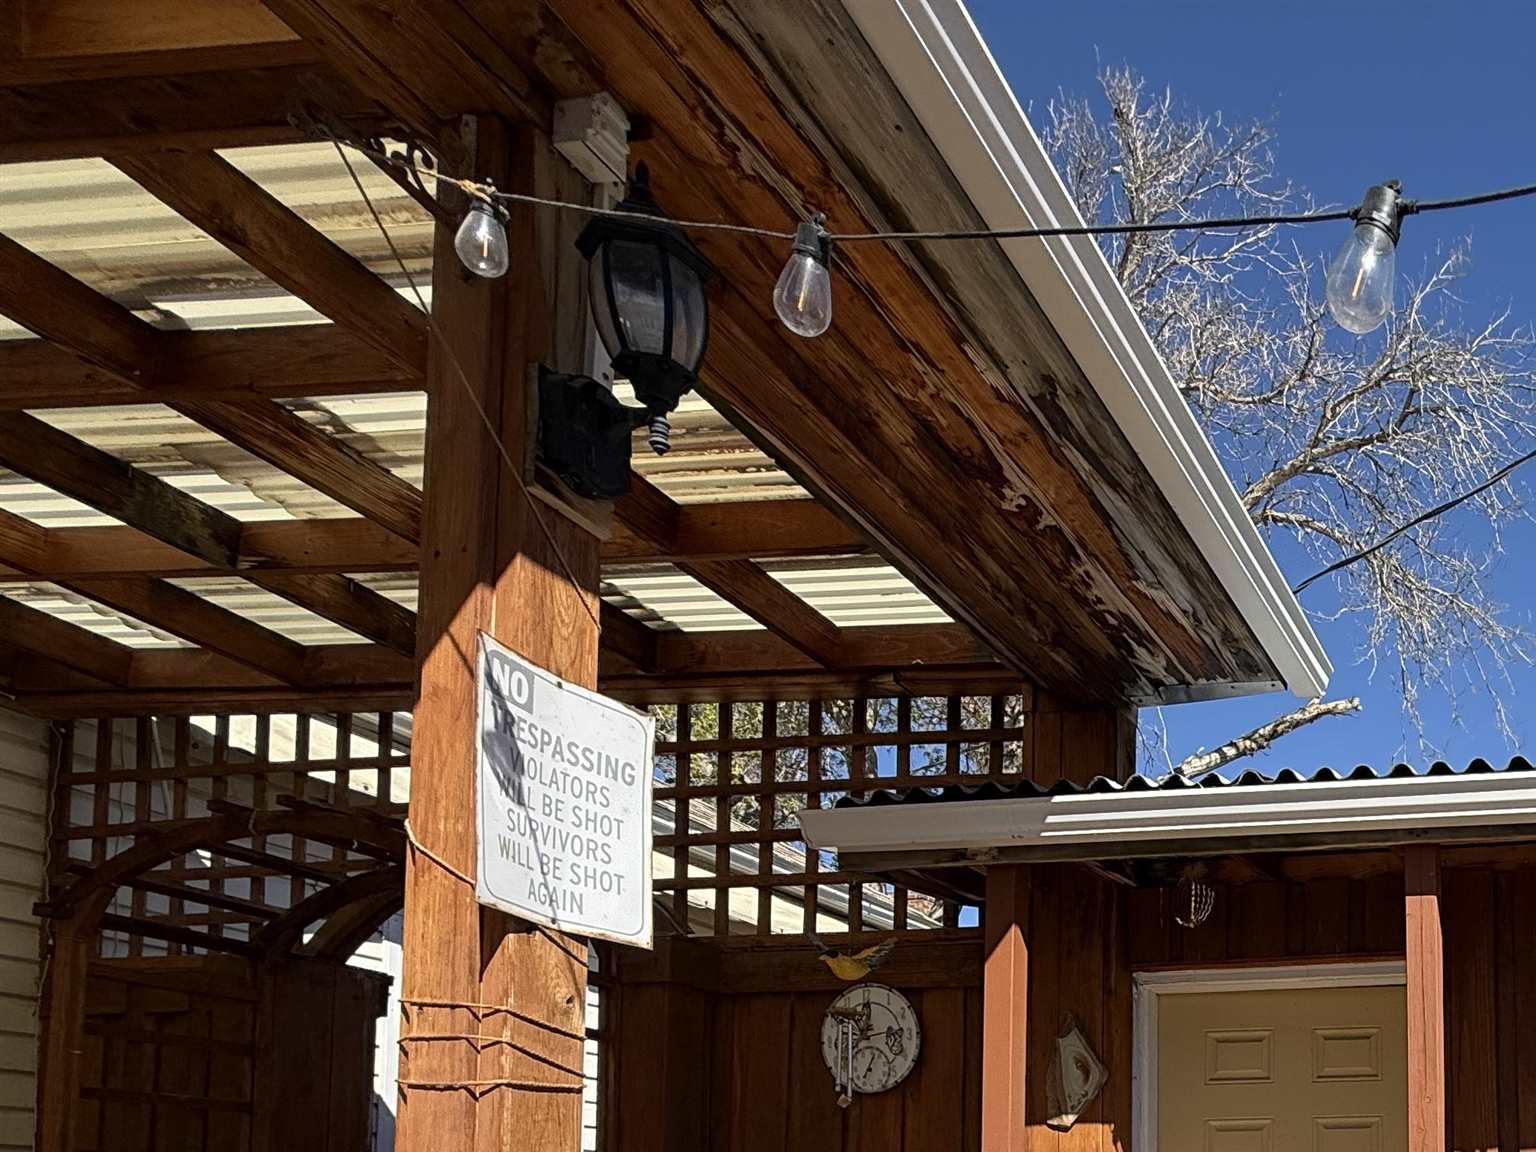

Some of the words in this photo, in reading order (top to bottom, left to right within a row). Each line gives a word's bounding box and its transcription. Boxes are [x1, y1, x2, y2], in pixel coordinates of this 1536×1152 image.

[491, 657, 530, 705] NO
[490, 699, 636, 787] TRESPASSING
[509, 746, 610, 808] VIOLATORS
[499, 777, 536, 811] WILL
[542, 793, 565, 823] BE
[571, 805, 625, 840] SHOT
[506, 807, 612, 865] SURVIVORS
[497, 833, 534, 872] WILL
[540, 853, 563, 880] BE
[569, 862, 625, 895] SHOT
[528, 877, 584, 915] AGAIN
